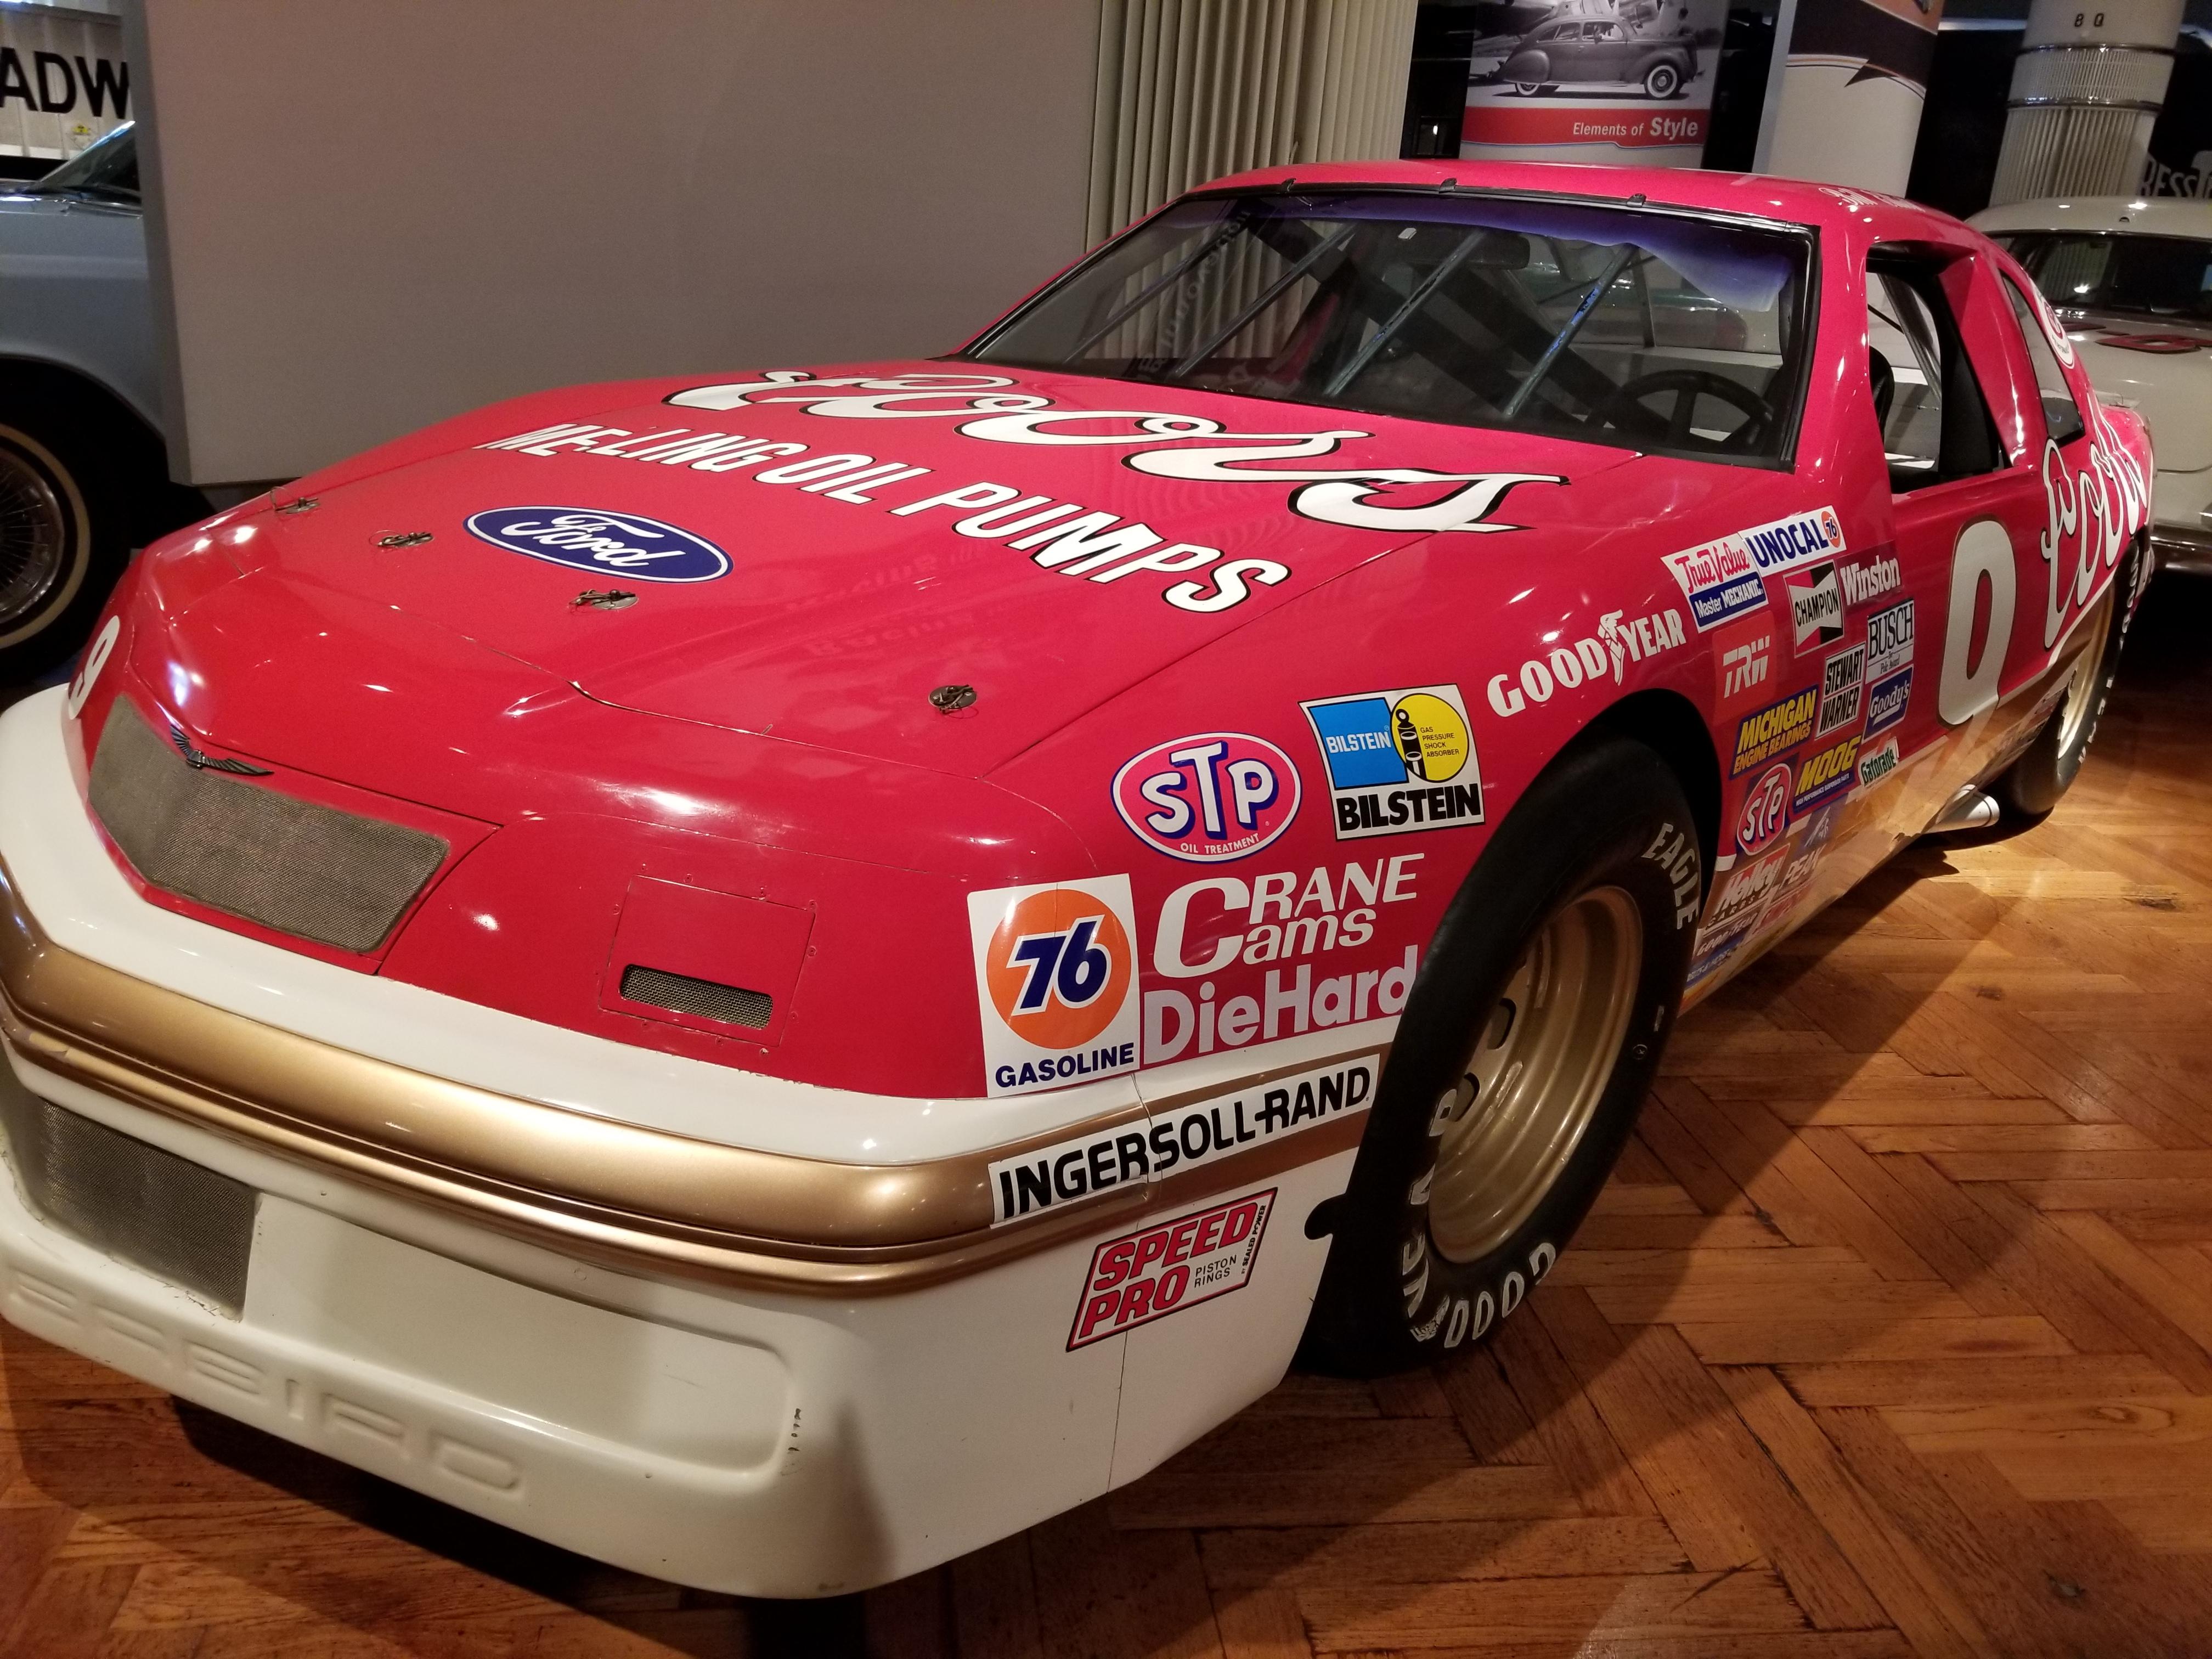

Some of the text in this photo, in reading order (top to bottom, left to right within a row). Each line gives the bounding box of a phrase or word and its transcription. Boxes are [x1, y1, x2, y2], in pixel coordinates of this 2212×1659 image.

[1573, 117, 1699, 140] Elements of Style
[472, 424, 811, 473] MELING
[752, 454, 936, 505] OIL
[888, 480, 1293, 613] PUMPS
[500, 515, 686, 566] Ford
[1745, 517, 1838, 567] UNOCAL 76
[1674, 541, 1750, 594] True Value
[1839, 555, 1901, 606] Winston
[1694, 596, 1723, 618] Master
[1795, 588, 1839, 627] CHAMPION
[1868, 603, 1914, 661] BUSCH
[1723, 635, 1770, 698] TRW
[1825, 648, 1864, 696] STEWART
[1736, 689, 1817, 754] MICHIGAN
[1819, 686, 1860, 733] WARNER
[1869, 680, 1910, 718] Goody's
[1325, 731, 1392, 753] BILSTEIN
[1426, 749, 1459, 758] ABSORBER
[1733, 720, 1812, 775] ENGINE BEARINGS
[1795, 735, 1862, 797] MOOG
[1860, 747, 1895, 787] Gatorade
[1140, 741, 1279, 840] STP
[1336, 783, 1481, 831] BILSTEIN
[1742, 772, 1785, 841] STP
[1180, 833, 1261, 855] OIL TREATMENT
[1641, 823, 1699, 930] EAGLE
[995, 915, 1111, 1016] 76
[1144, 945, 1419, 1065] DieHard
[995, 1042, 1134, 1088] GASOLINE
[1000, 1066, 1371, 1219] INGERSOLL-RAND
[1093, 1201, 1259, 1292] SPEED
[1243, 1238, 1256, 1266] SEALED
[1252, 1205, 1266, 1235] POWER
[1194, 1267, 1231, 1288] RINGS
[1195, 1255, 1237, 1278] PISTON
[1078, 1265, 1190, 1339] PRO
